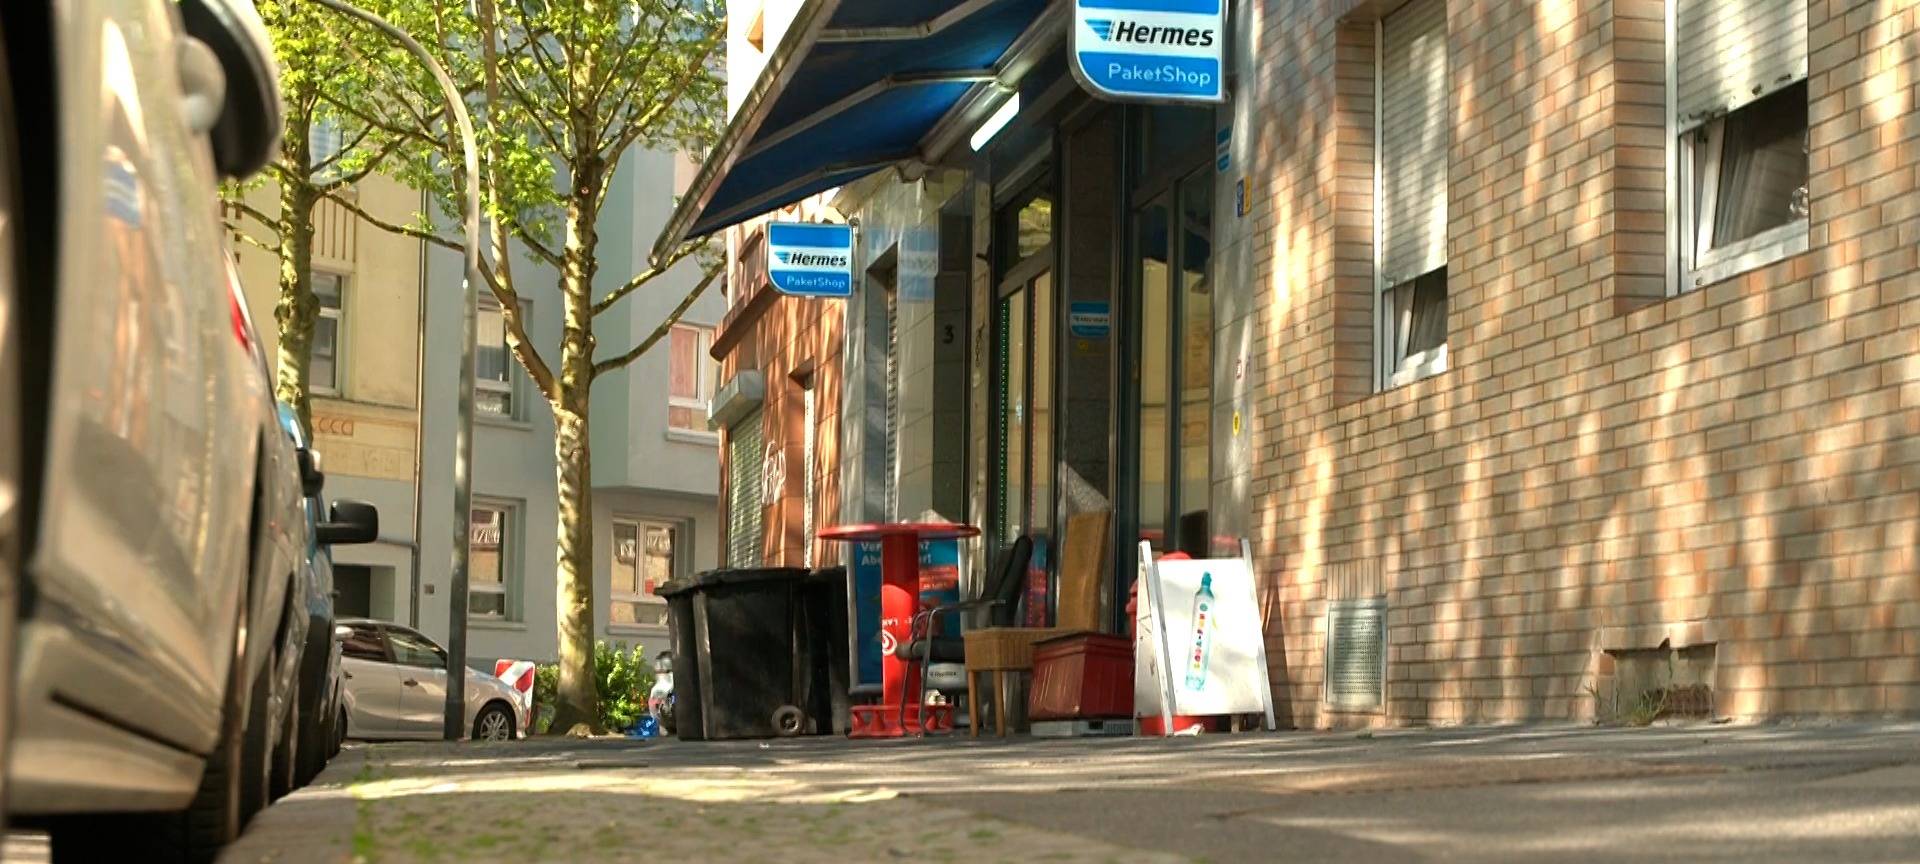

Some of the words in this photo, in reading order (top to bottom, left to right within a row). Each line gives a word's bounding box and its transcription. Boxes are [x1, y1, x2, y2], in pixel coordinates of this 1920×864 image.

[1115, 21, 1214, 46] Hermes
[1107, 62, 1212, 88] PaketShop
[791, 252, 848, 267] Hermes
[786, 274, 846, 289] PaketShop
[943, 324, 955, 344] 3
